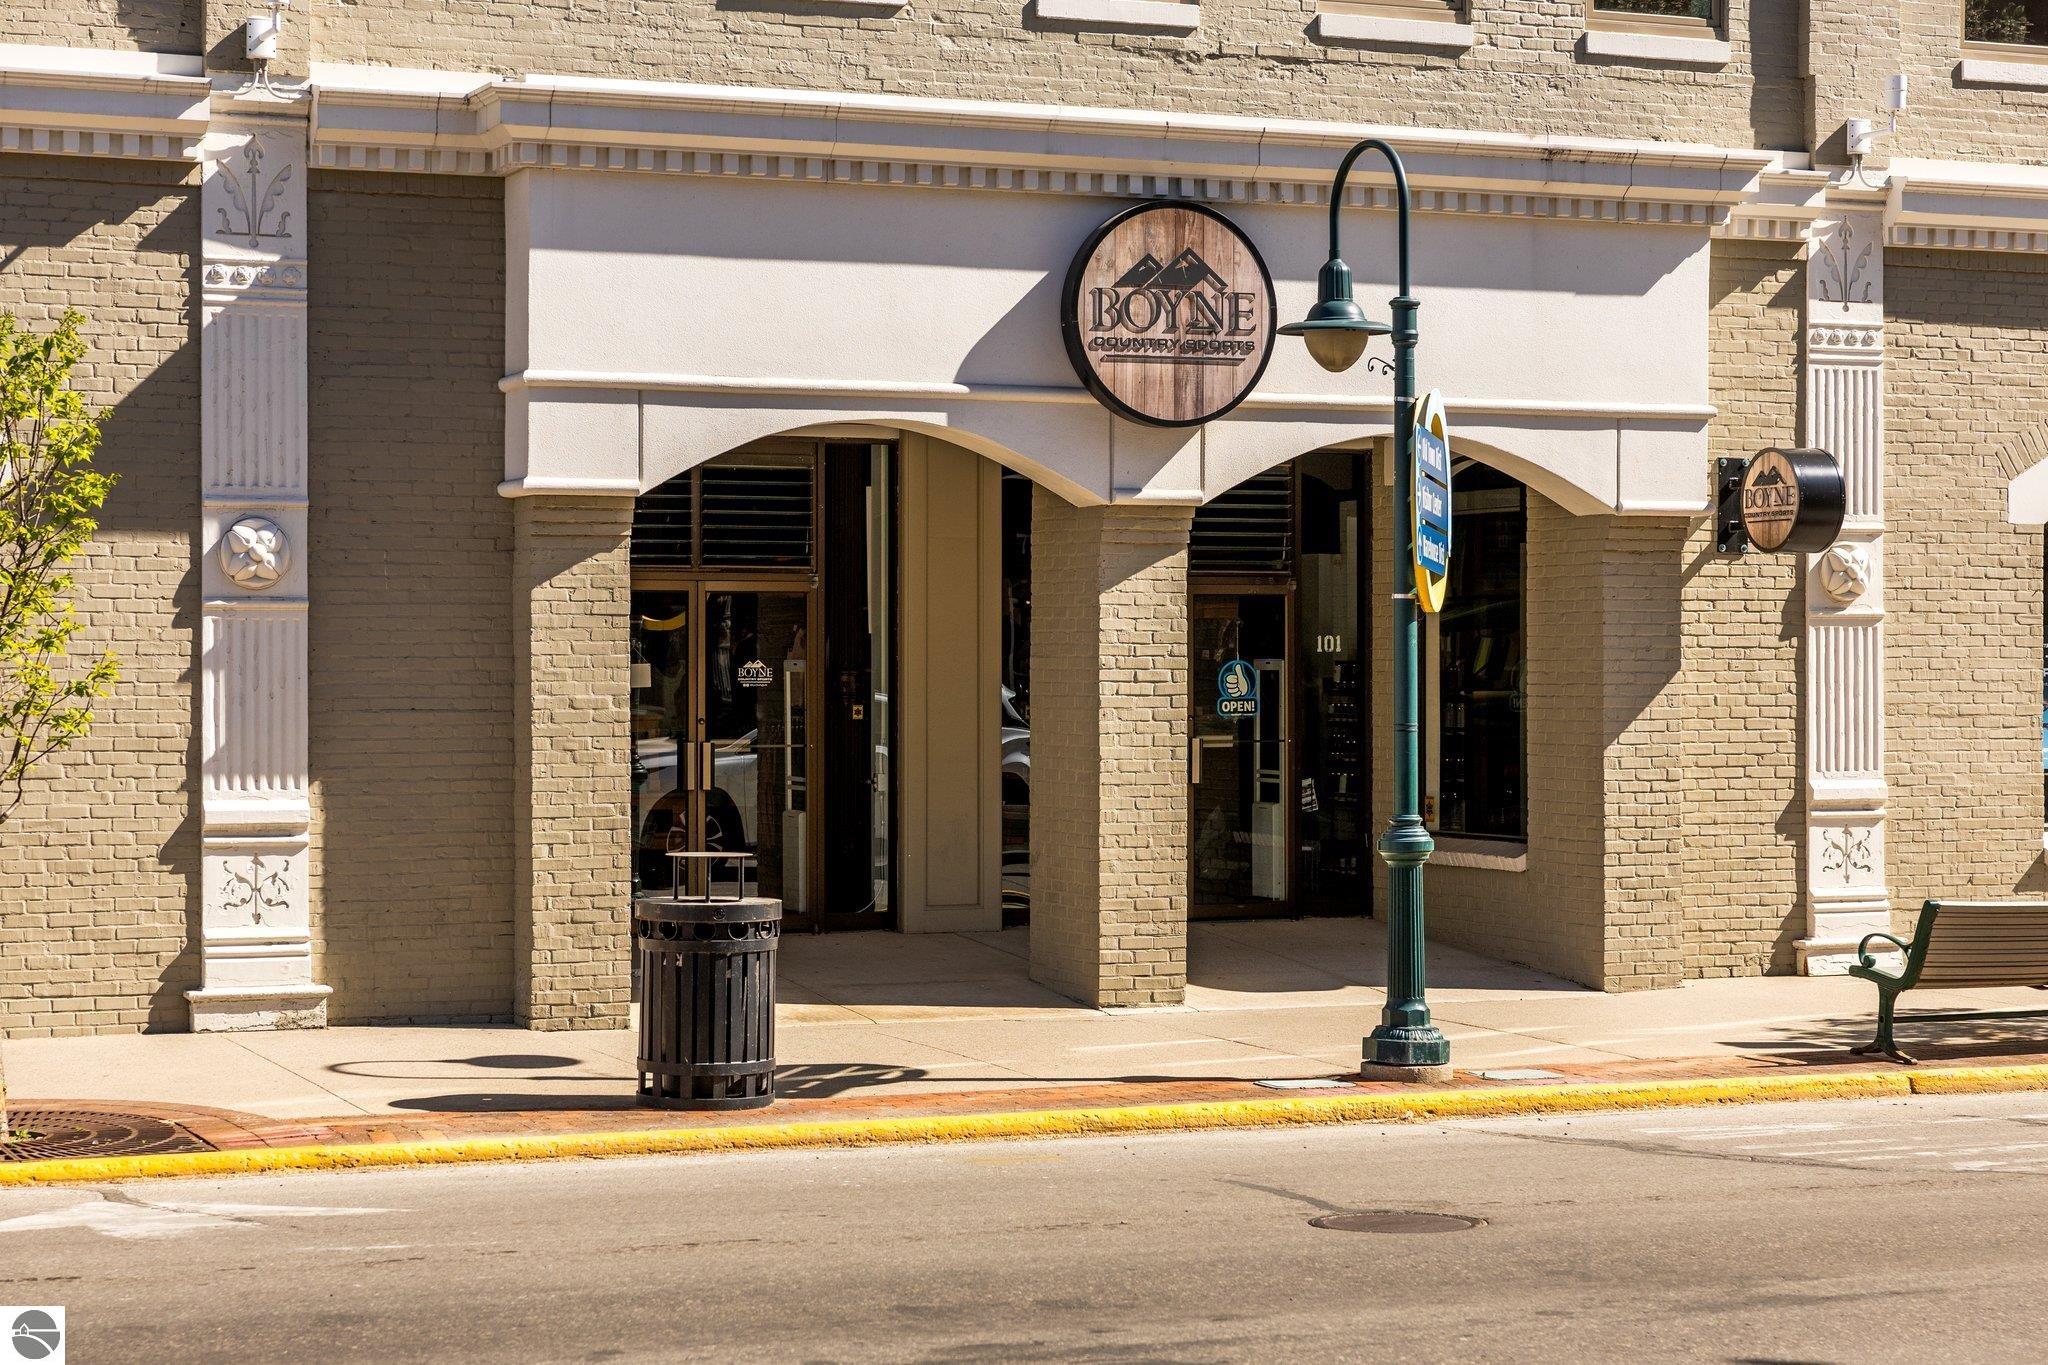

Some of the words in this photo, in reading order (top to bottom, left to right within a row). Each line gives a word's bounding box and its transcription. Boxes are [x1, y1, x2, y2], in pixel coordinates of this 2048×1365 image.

[1089, 287, 1256, 336] BOYNE
[1090, 337, 1180, 353] COUNTRY
[1181, 339, 1256, 356] SPORTS
[1432, 492, 1442, 518] Center
[1745, 486, 1795, 509] BOYNE
[1744, 511, 1770, 519] COUNTRY
[1771, 509, 1794, 517] SPORTS
[1423, 534, 1438, 563] Warehouse
[1316, 635, 1341, 653] 101
[737, 668, 773, 677] BOYNE
[1221, 701, 1255, 712] OPEN!
